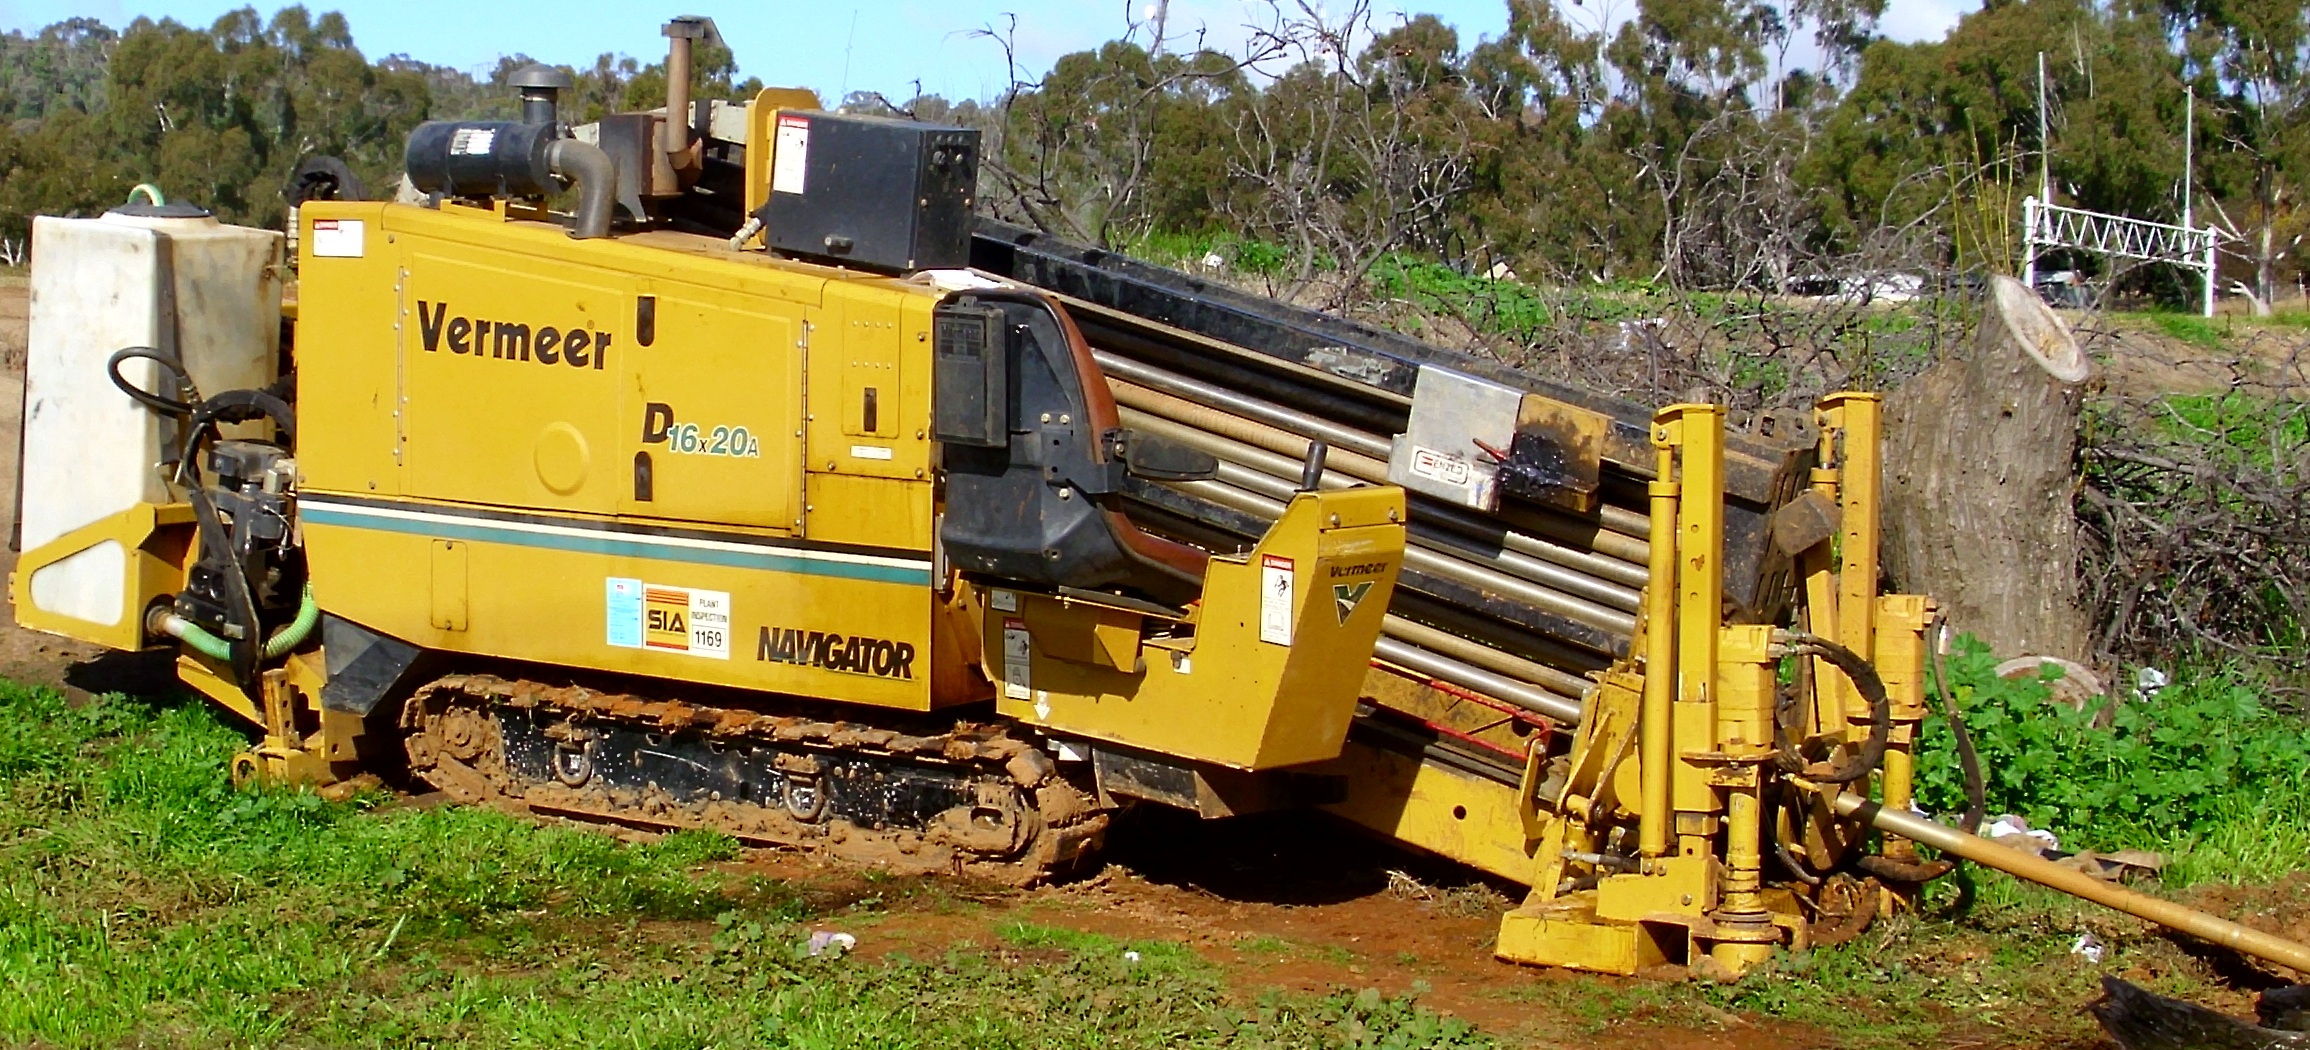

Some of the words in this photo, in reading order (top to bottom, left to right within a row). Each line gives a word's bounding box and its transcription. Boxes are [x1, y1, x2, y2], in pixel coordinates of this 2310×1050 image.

[417, 300, 612, 370] Vermeer
[1330, 562, 1388, 578] Vermeer
[700, 599, 719, 609] PLANT
[648, 609, 686, 633] SIA
[695, 630, 722, 647] 1169
[757, 626, 915, 679] NAVIGATOR
